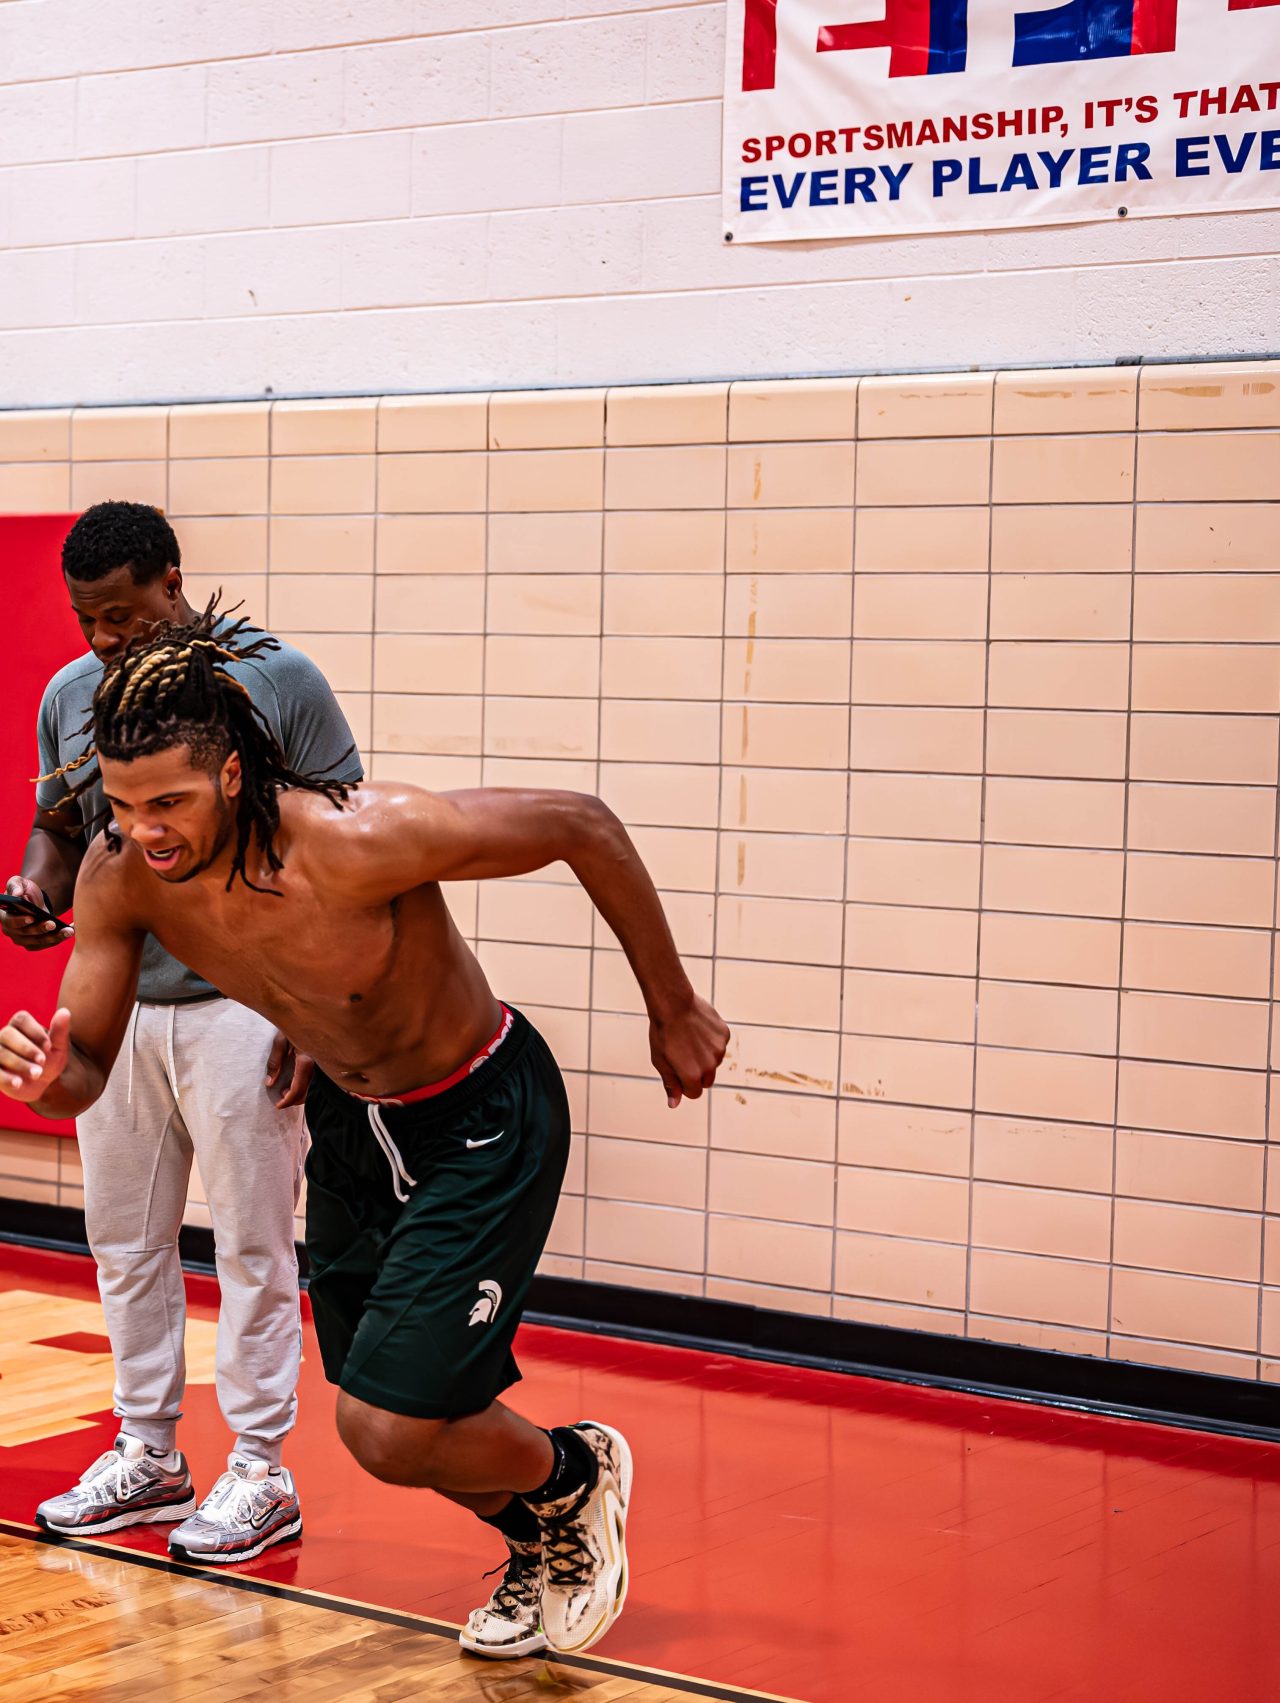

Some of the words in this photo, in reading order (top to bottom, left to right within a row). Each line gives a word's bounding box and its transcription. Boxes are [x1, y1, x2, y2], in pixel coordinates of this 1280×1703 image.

[741, 106, 1069, 164] SPORTSMANSHIP,
[1084, 95, 1159, 130] IT'S
[1172, 81, 1280, 118] THAT
[739, 163, 910, 212] EVERY
[932, 142, 1153, 198] PLAYER
